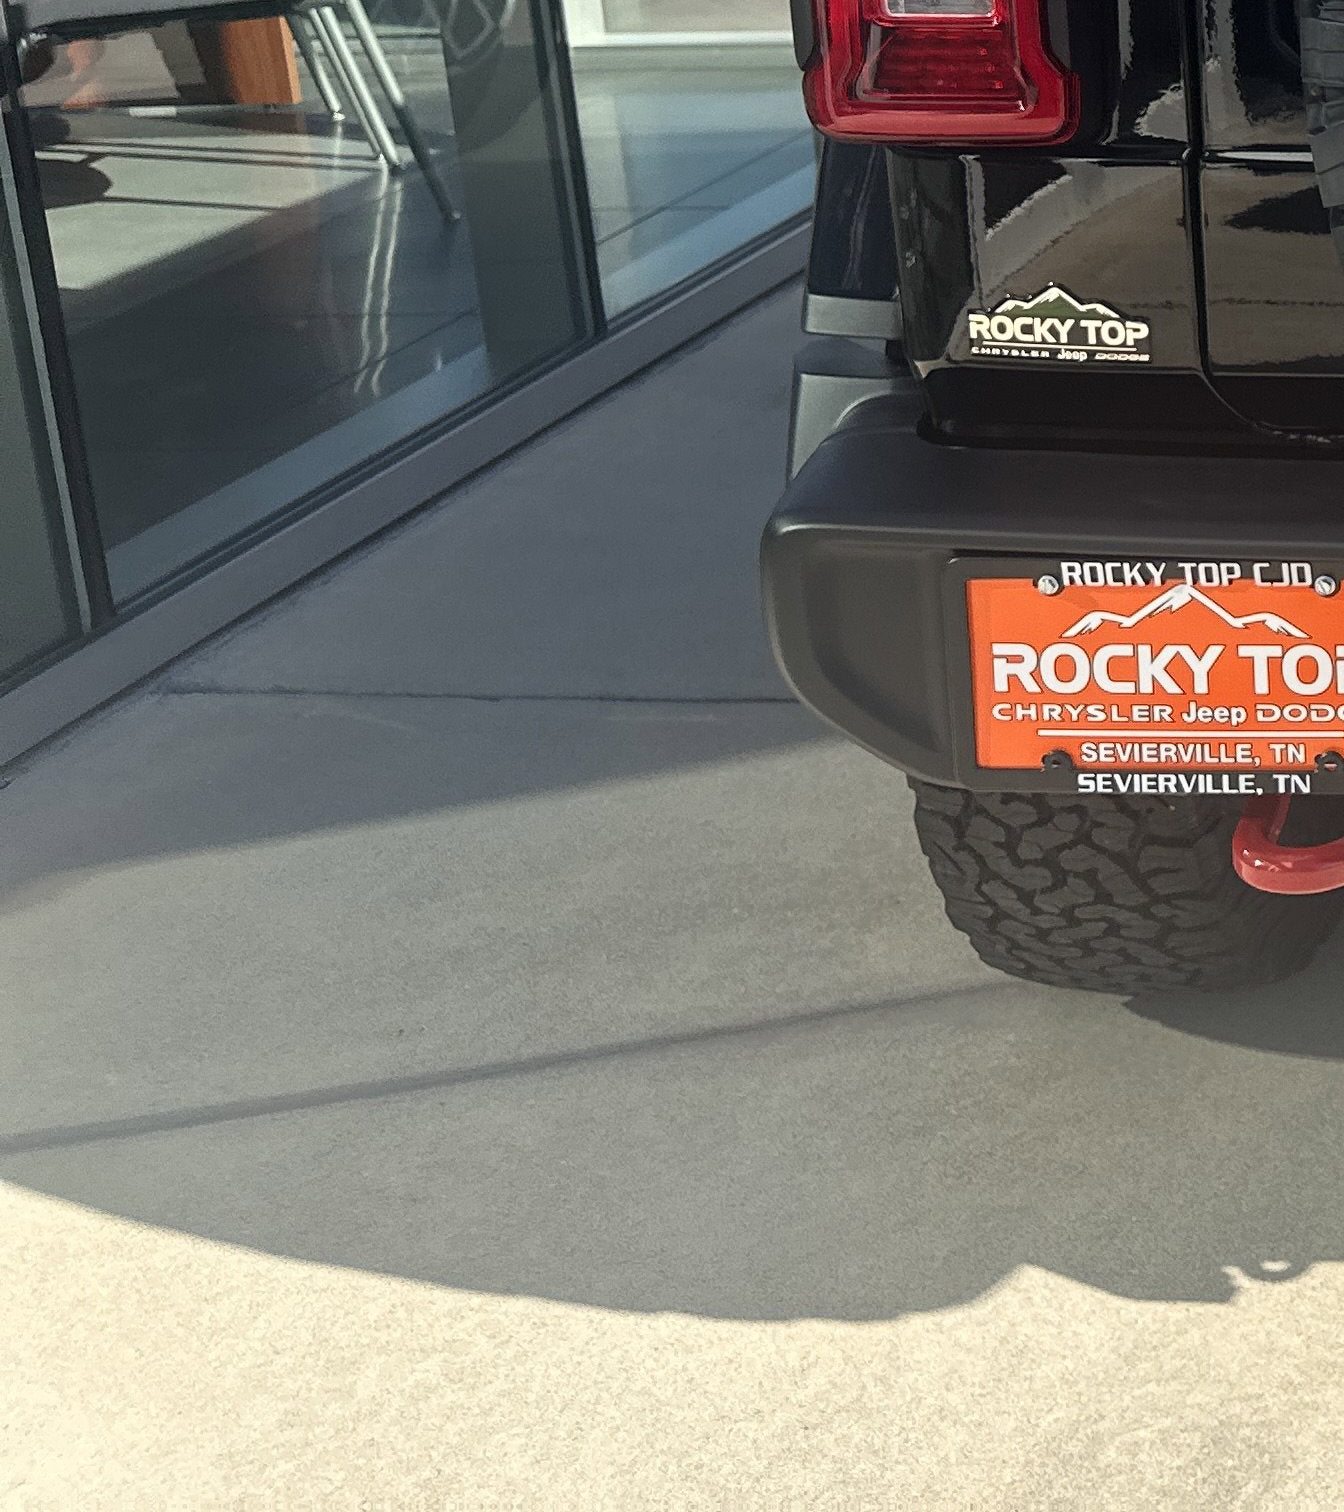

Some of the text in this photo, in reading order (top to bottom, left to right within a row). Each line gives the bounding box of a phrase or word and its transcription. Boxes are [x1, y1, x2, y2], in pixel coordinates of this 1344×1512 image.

[968, 313, 1150, 346] ROCKY TOP
[1056, 348, 1088, 362] Jeep
[1060, 561, 1313, 587] ROCKY TOP CJD
[992, 643, 1226, 695] ROCKY
[992, 702, 1174, 723] CHRYSLER
[1181, 700, 1247, 727] Jeep
[1080, 742, 1306, 767] SEVIERVILLE, TN
[1077, 773, 1311, 796] SEVIERVILLE, TN
